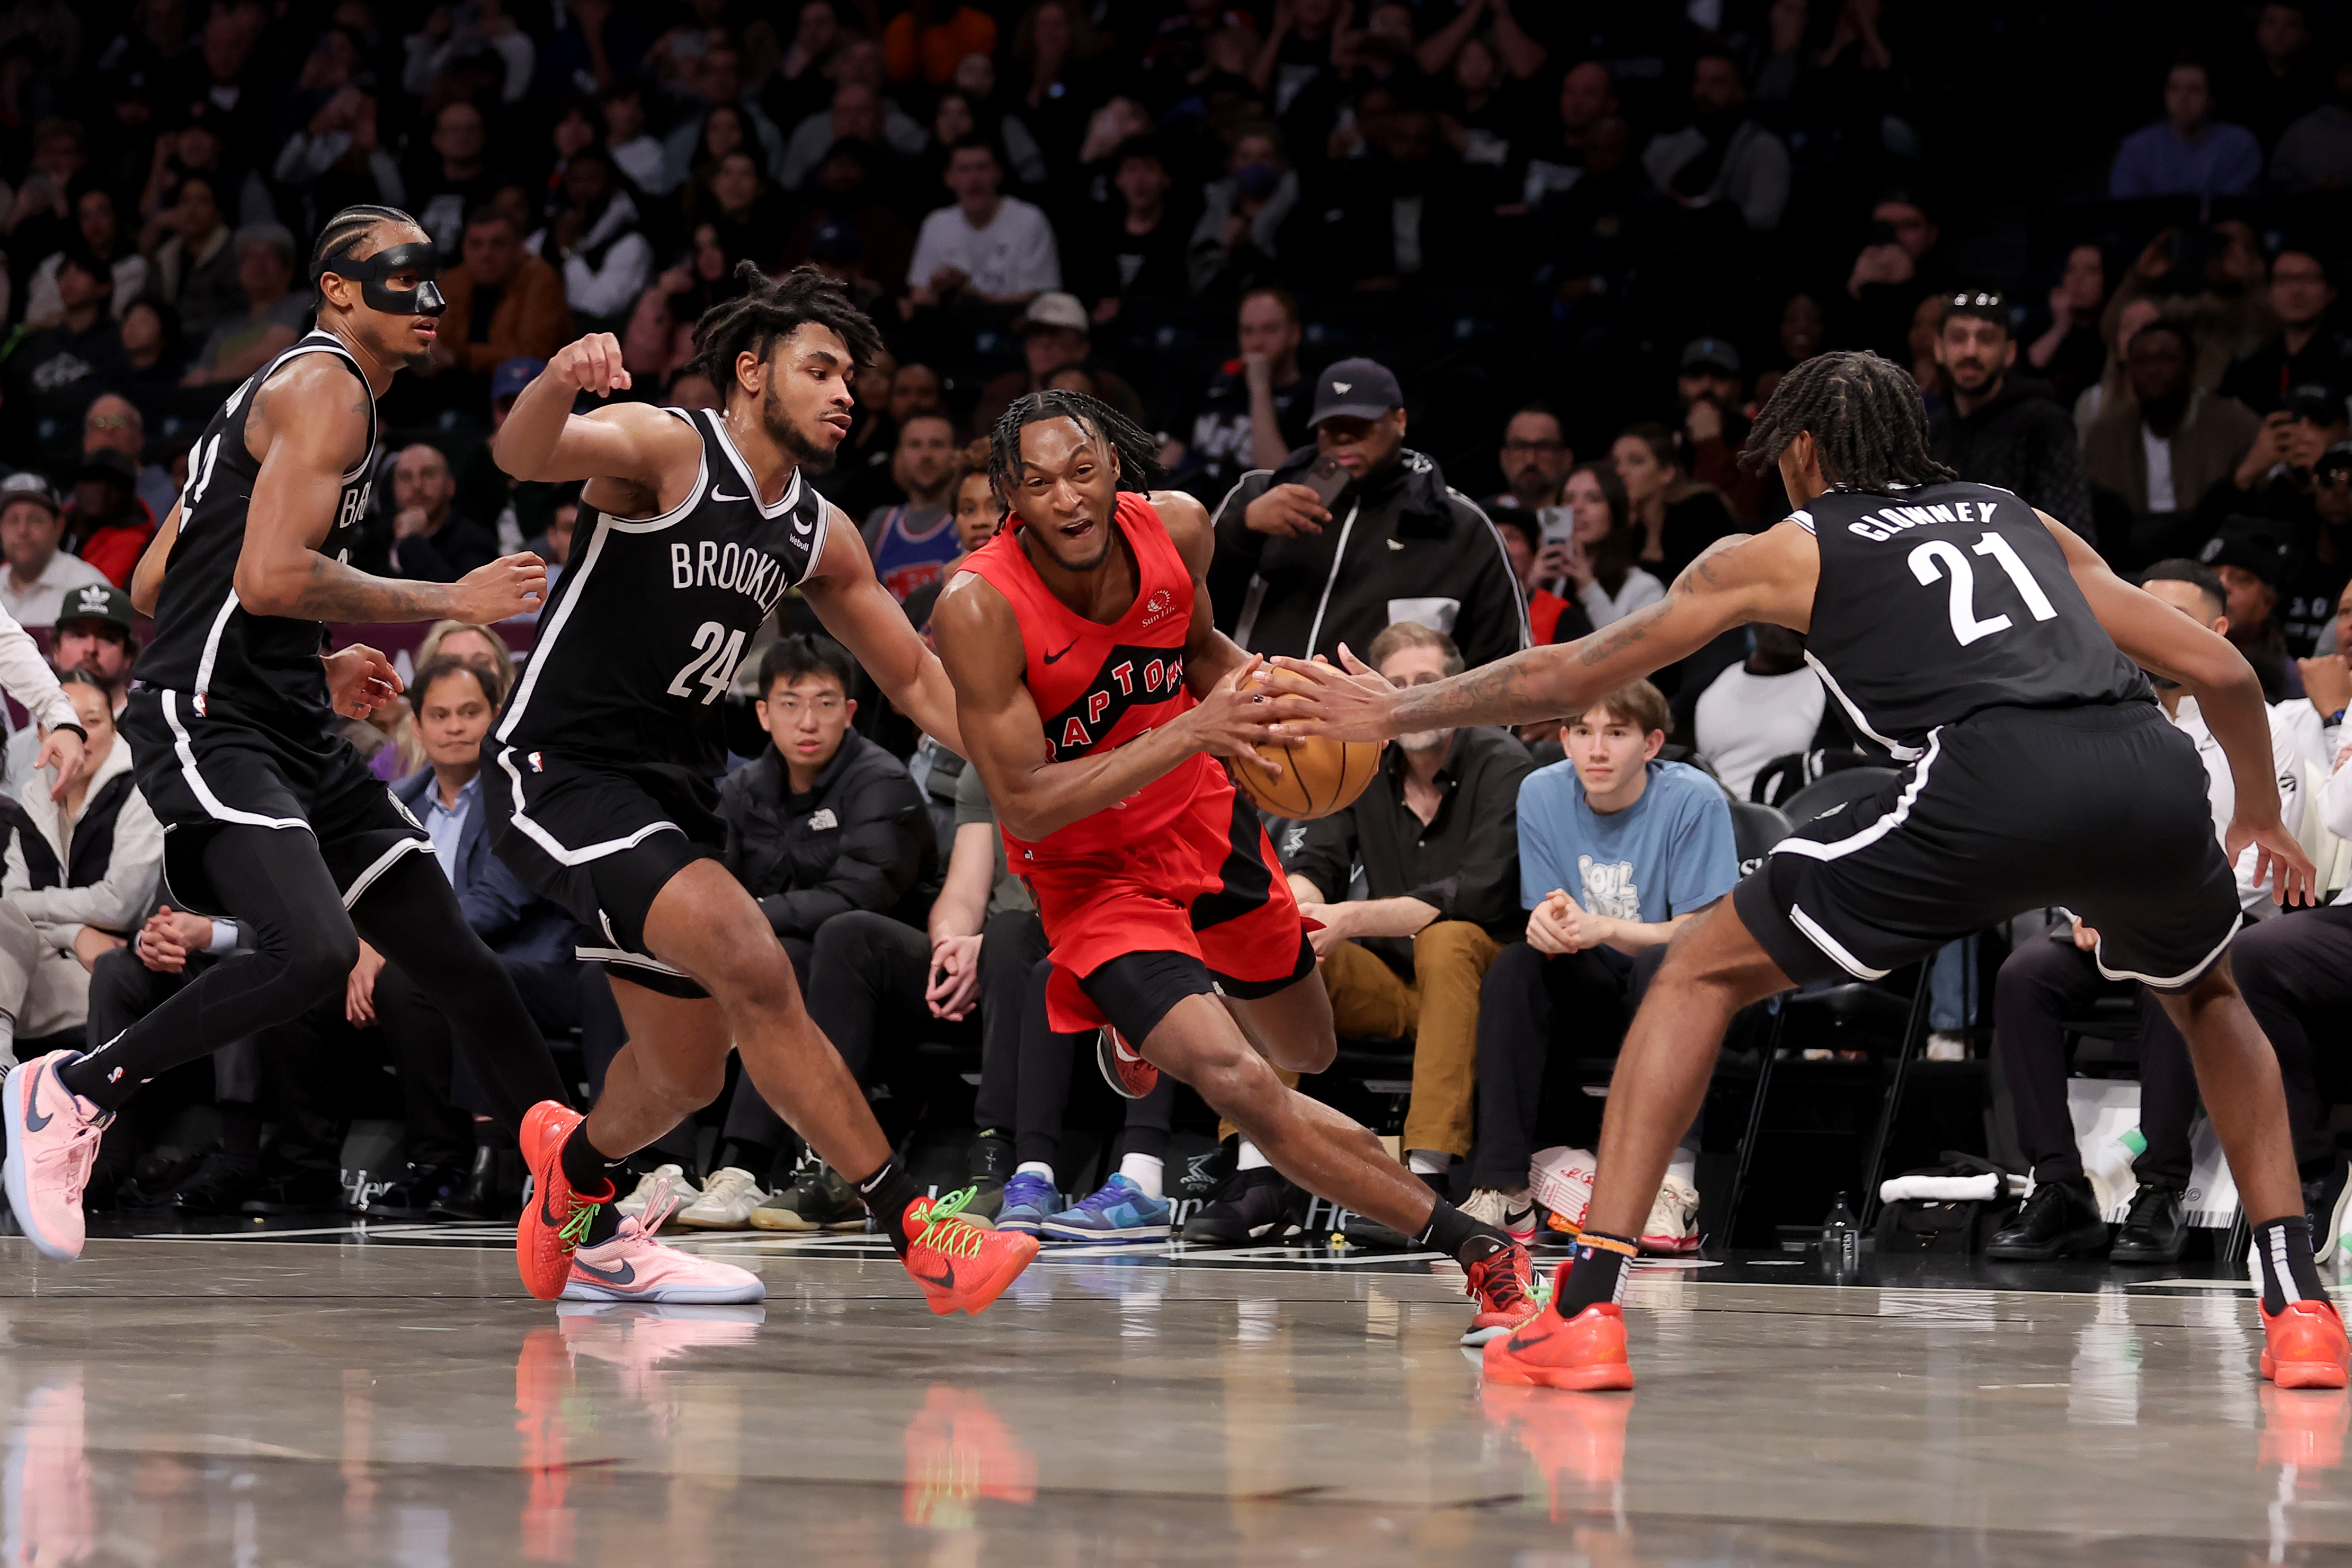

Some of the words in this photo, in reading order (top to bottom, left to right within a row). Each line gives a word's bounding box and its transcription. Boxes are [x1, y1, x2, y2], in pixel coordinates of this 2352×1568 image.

[789, 533, 809, 552] Webull
[1848, 501, 1998, 542] CLOWNEY
[671, 541, 788, 621] BROOKLY
[1907, 531, 2059, 647] 21
[1142, 614, 1160, 628] Sun
[667, 621, 746, 706] 24
